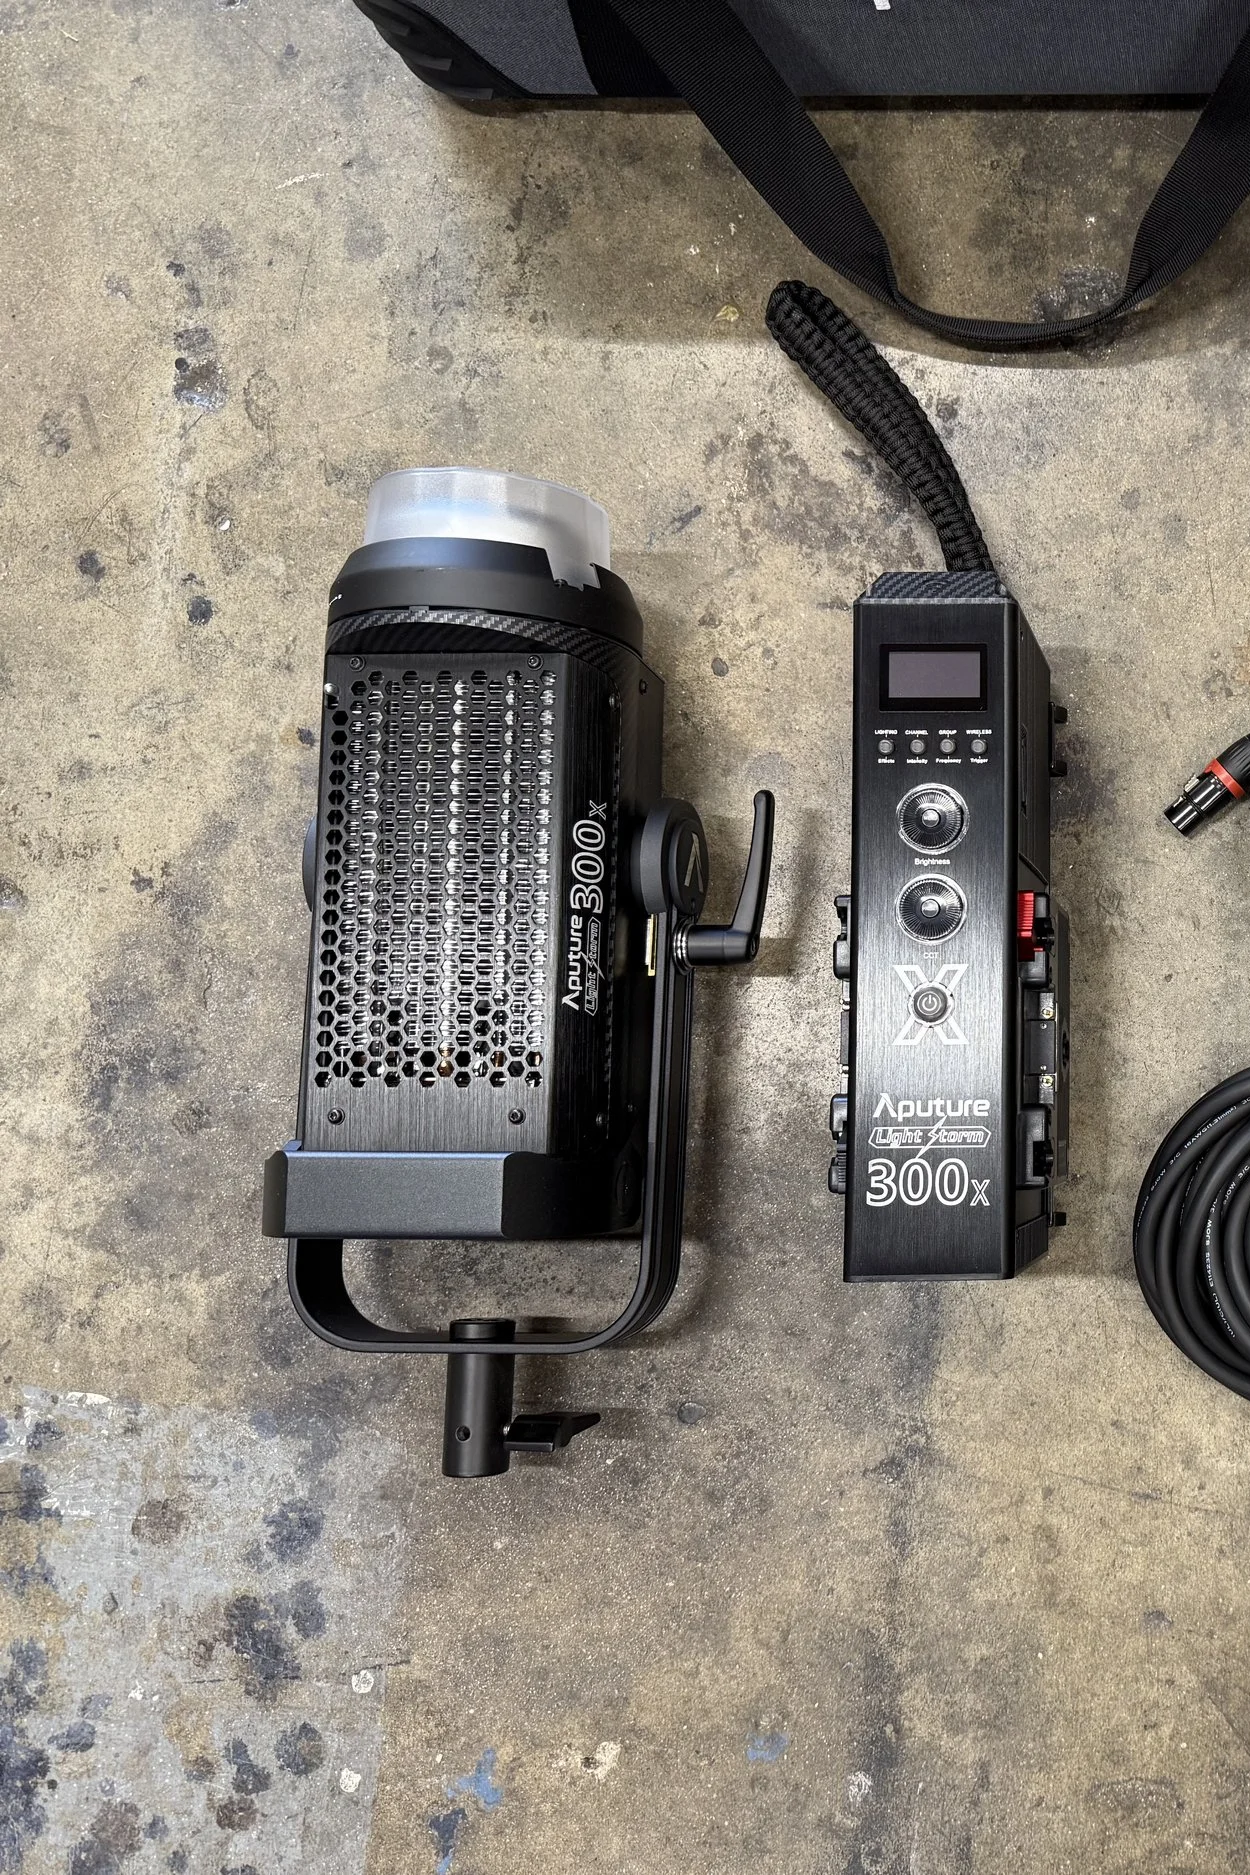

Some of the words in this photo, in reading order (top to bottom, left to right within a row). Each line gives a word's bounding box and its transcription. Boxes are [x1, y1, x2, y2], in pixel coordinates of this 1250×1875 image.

[570, 800, 607, 914] 300x
[914, 857, 951, 866] Brightness
[561, 914, 583, 1011] Aputure
[923, 951, 939, 959] CCT
[872, 1092, 991, 1122] Aputure
[875, 1128, 923, 1147] Light
[866, 1157, 991, 1207] 300x
